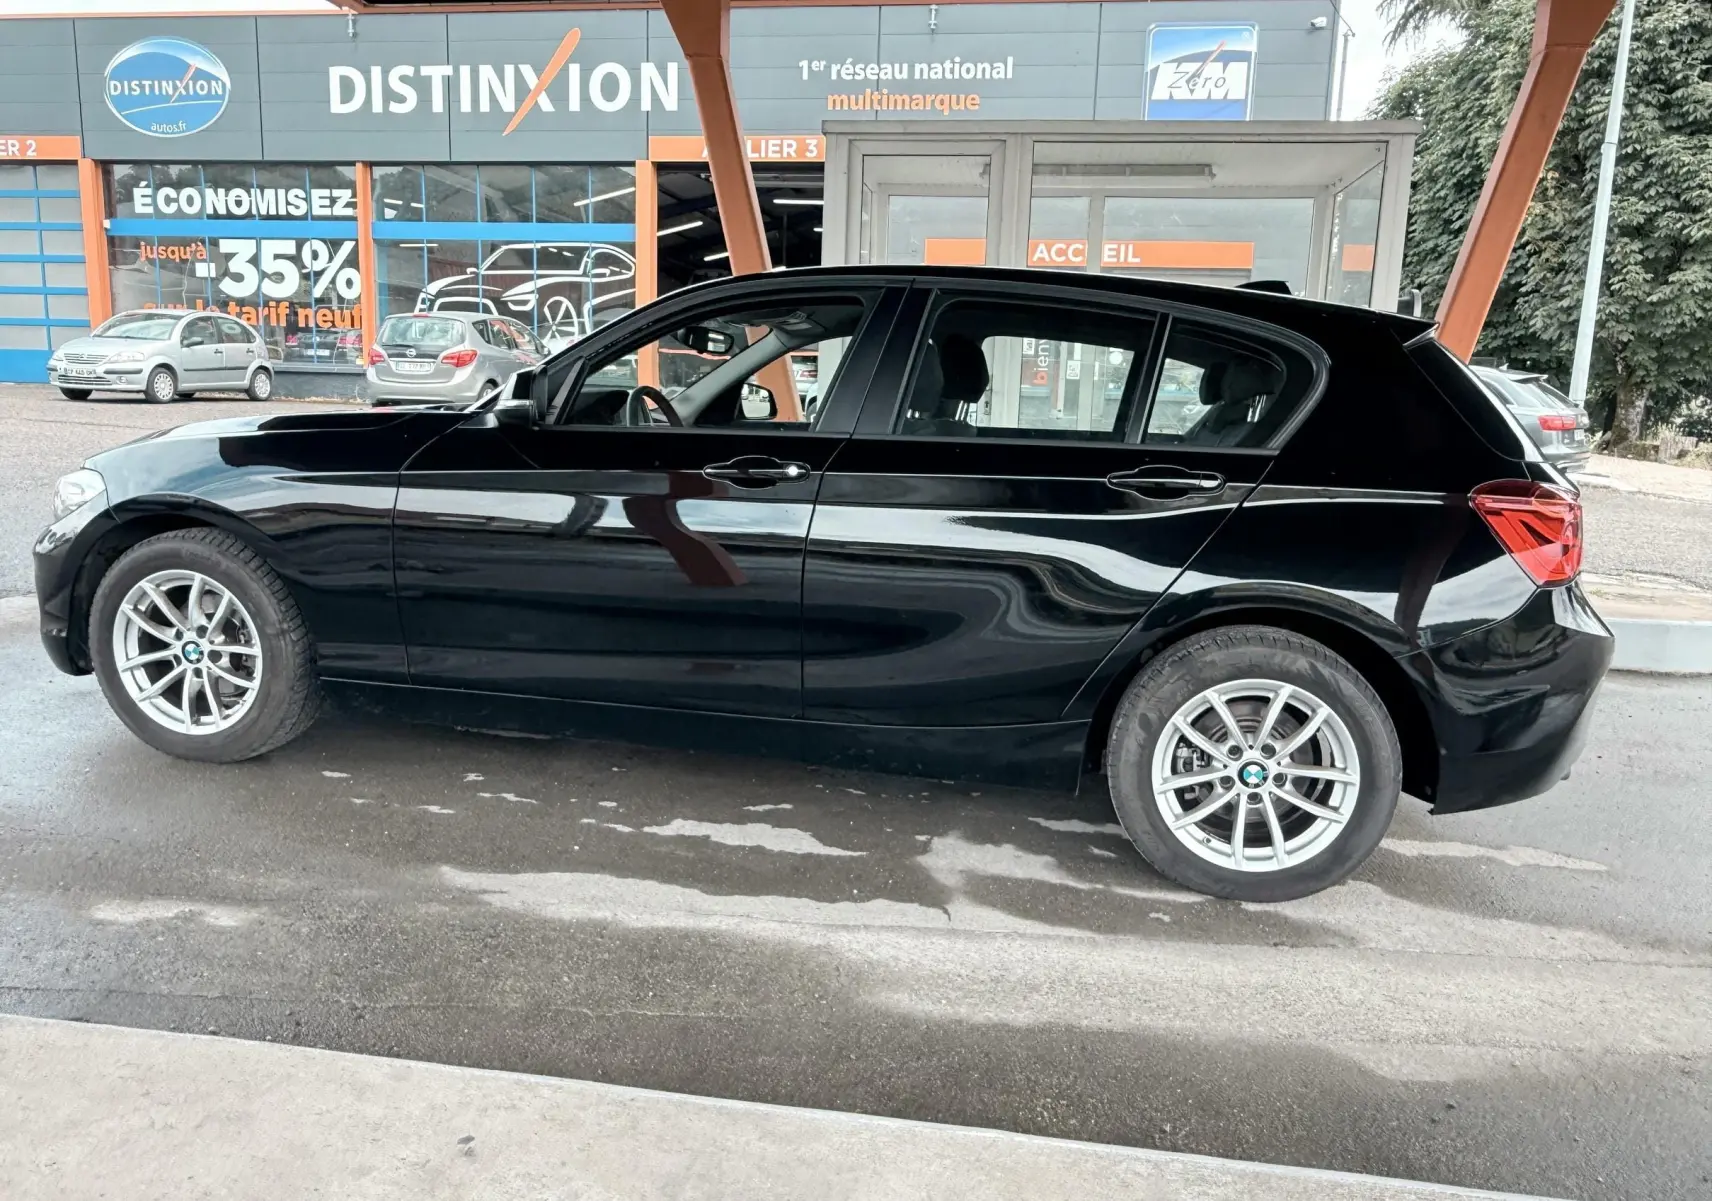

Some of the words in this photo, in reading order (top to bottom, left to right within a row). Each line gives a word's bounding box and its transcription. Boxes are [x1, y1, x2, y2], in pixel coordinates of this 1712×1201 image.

[799, 60, 826, 80] 1er
[831, 58, 908, 80] réseau
[914, 56, 1014, 80] national
[110, 76, 223, 100] DISTINXION
[329, 50, 680, 123] DISTINXION
[827, 88, 980, 115] multimarque
[151, 121, 187, 133] autos.fr
[26, 139, 37, 157] 2
[805, 139, 818, 158] 3
[133, 181, 356, 216] ÉCONOMISEZ
[1032, 243, 1141, 262] ACCEIL
[195, 238, 361, 299] -35%
[228, 301, 289, 327] tarif
